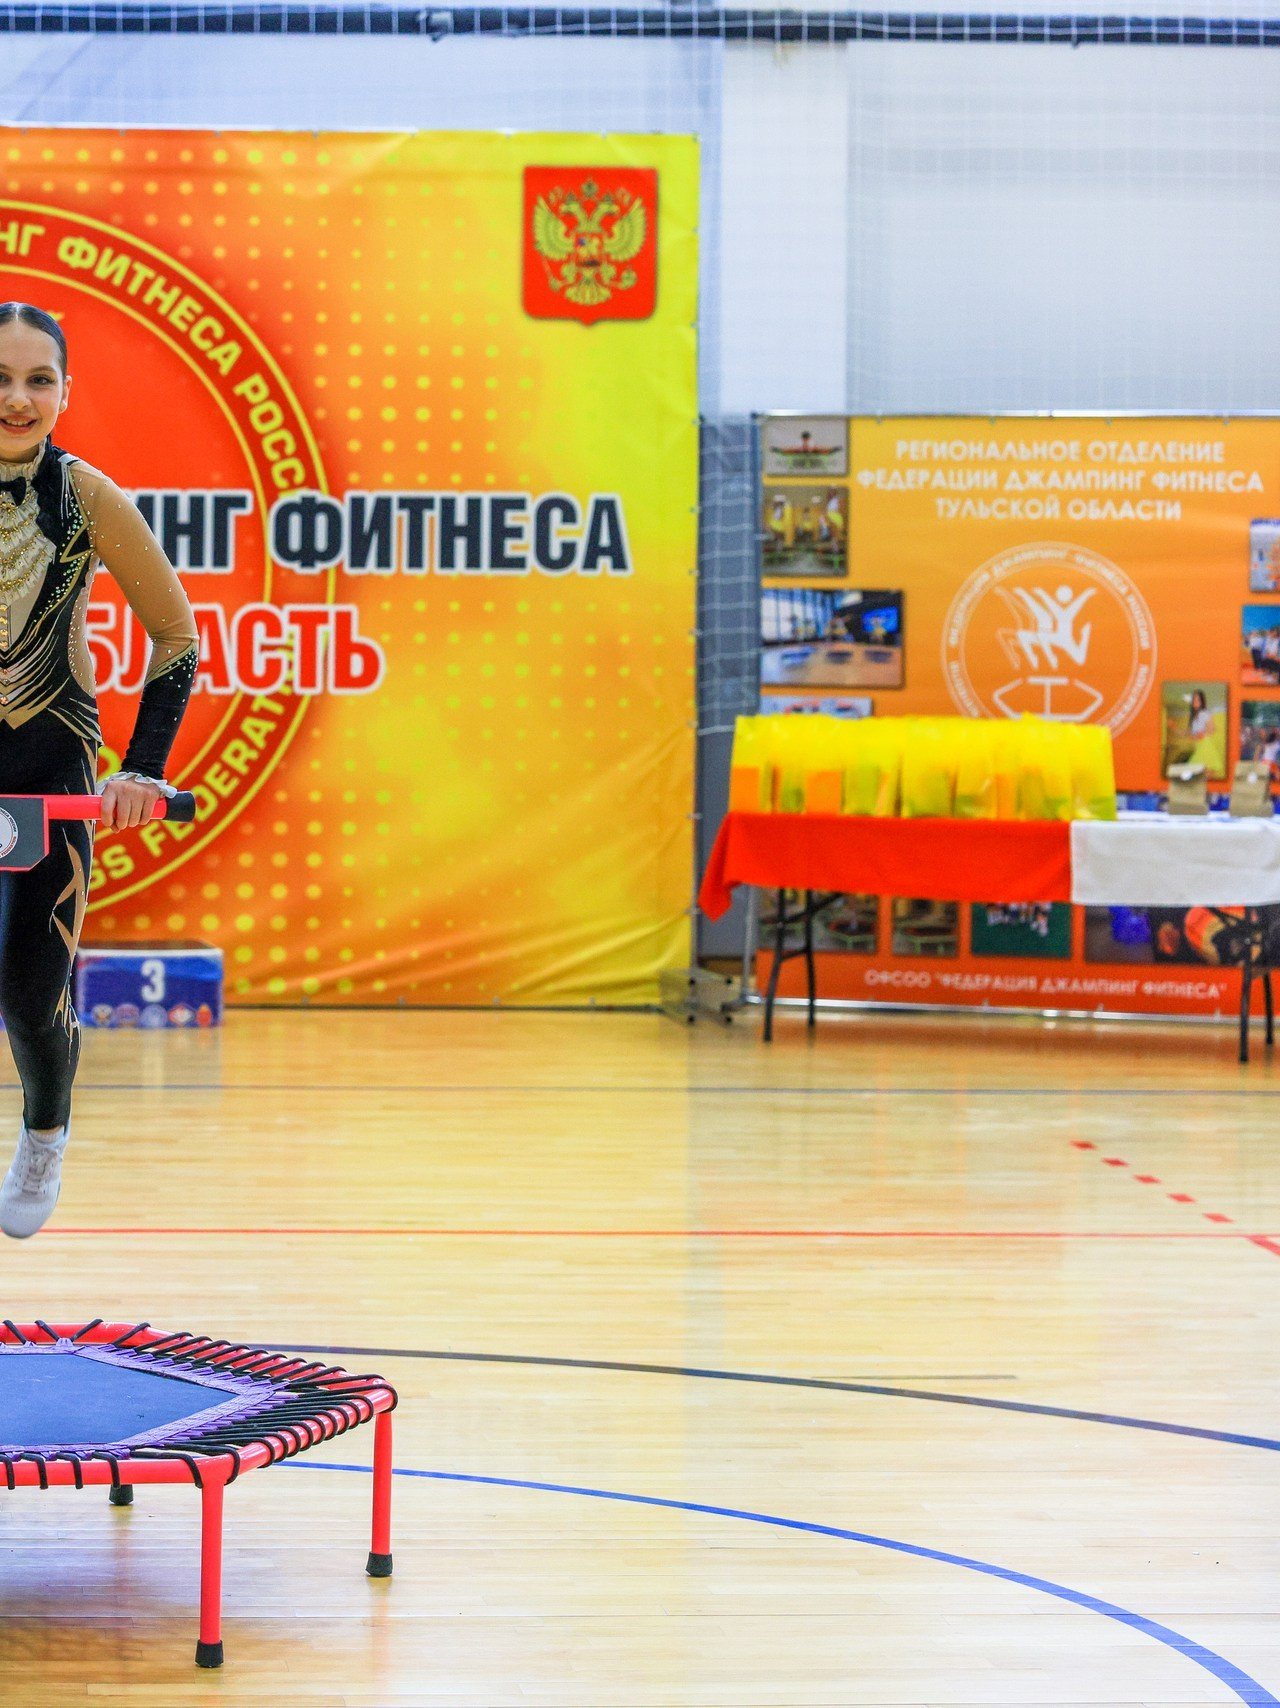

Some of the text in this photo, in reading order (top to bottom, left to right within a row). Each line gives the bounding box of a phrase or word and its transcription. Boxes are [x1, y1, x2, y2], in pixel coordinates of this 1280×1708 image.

[58, 235, 243, 376] ФИТНЕСА
[232, 372, 308, 497] РОСС
[895, 439, 1225, 465] РЕГИОНАЛЬНОЕ ОТДЕЛЕНИЕ
[855, 468, 1265, 494] ФЕДЕРАЦИИ ДЖАМПИНГ ФИТНЕСА
[935, 494, 1182, 521] ТУЛЬСКОЙ ОБЛАСТИ
[268, 488, 632, 575] ФИТНЕСА
[85, 602, 385, 696] БЛАСТЬ
[141, 958, 166, 1003] 3
[1040, 976, 1138, 996] ДЖАМПИНГ
